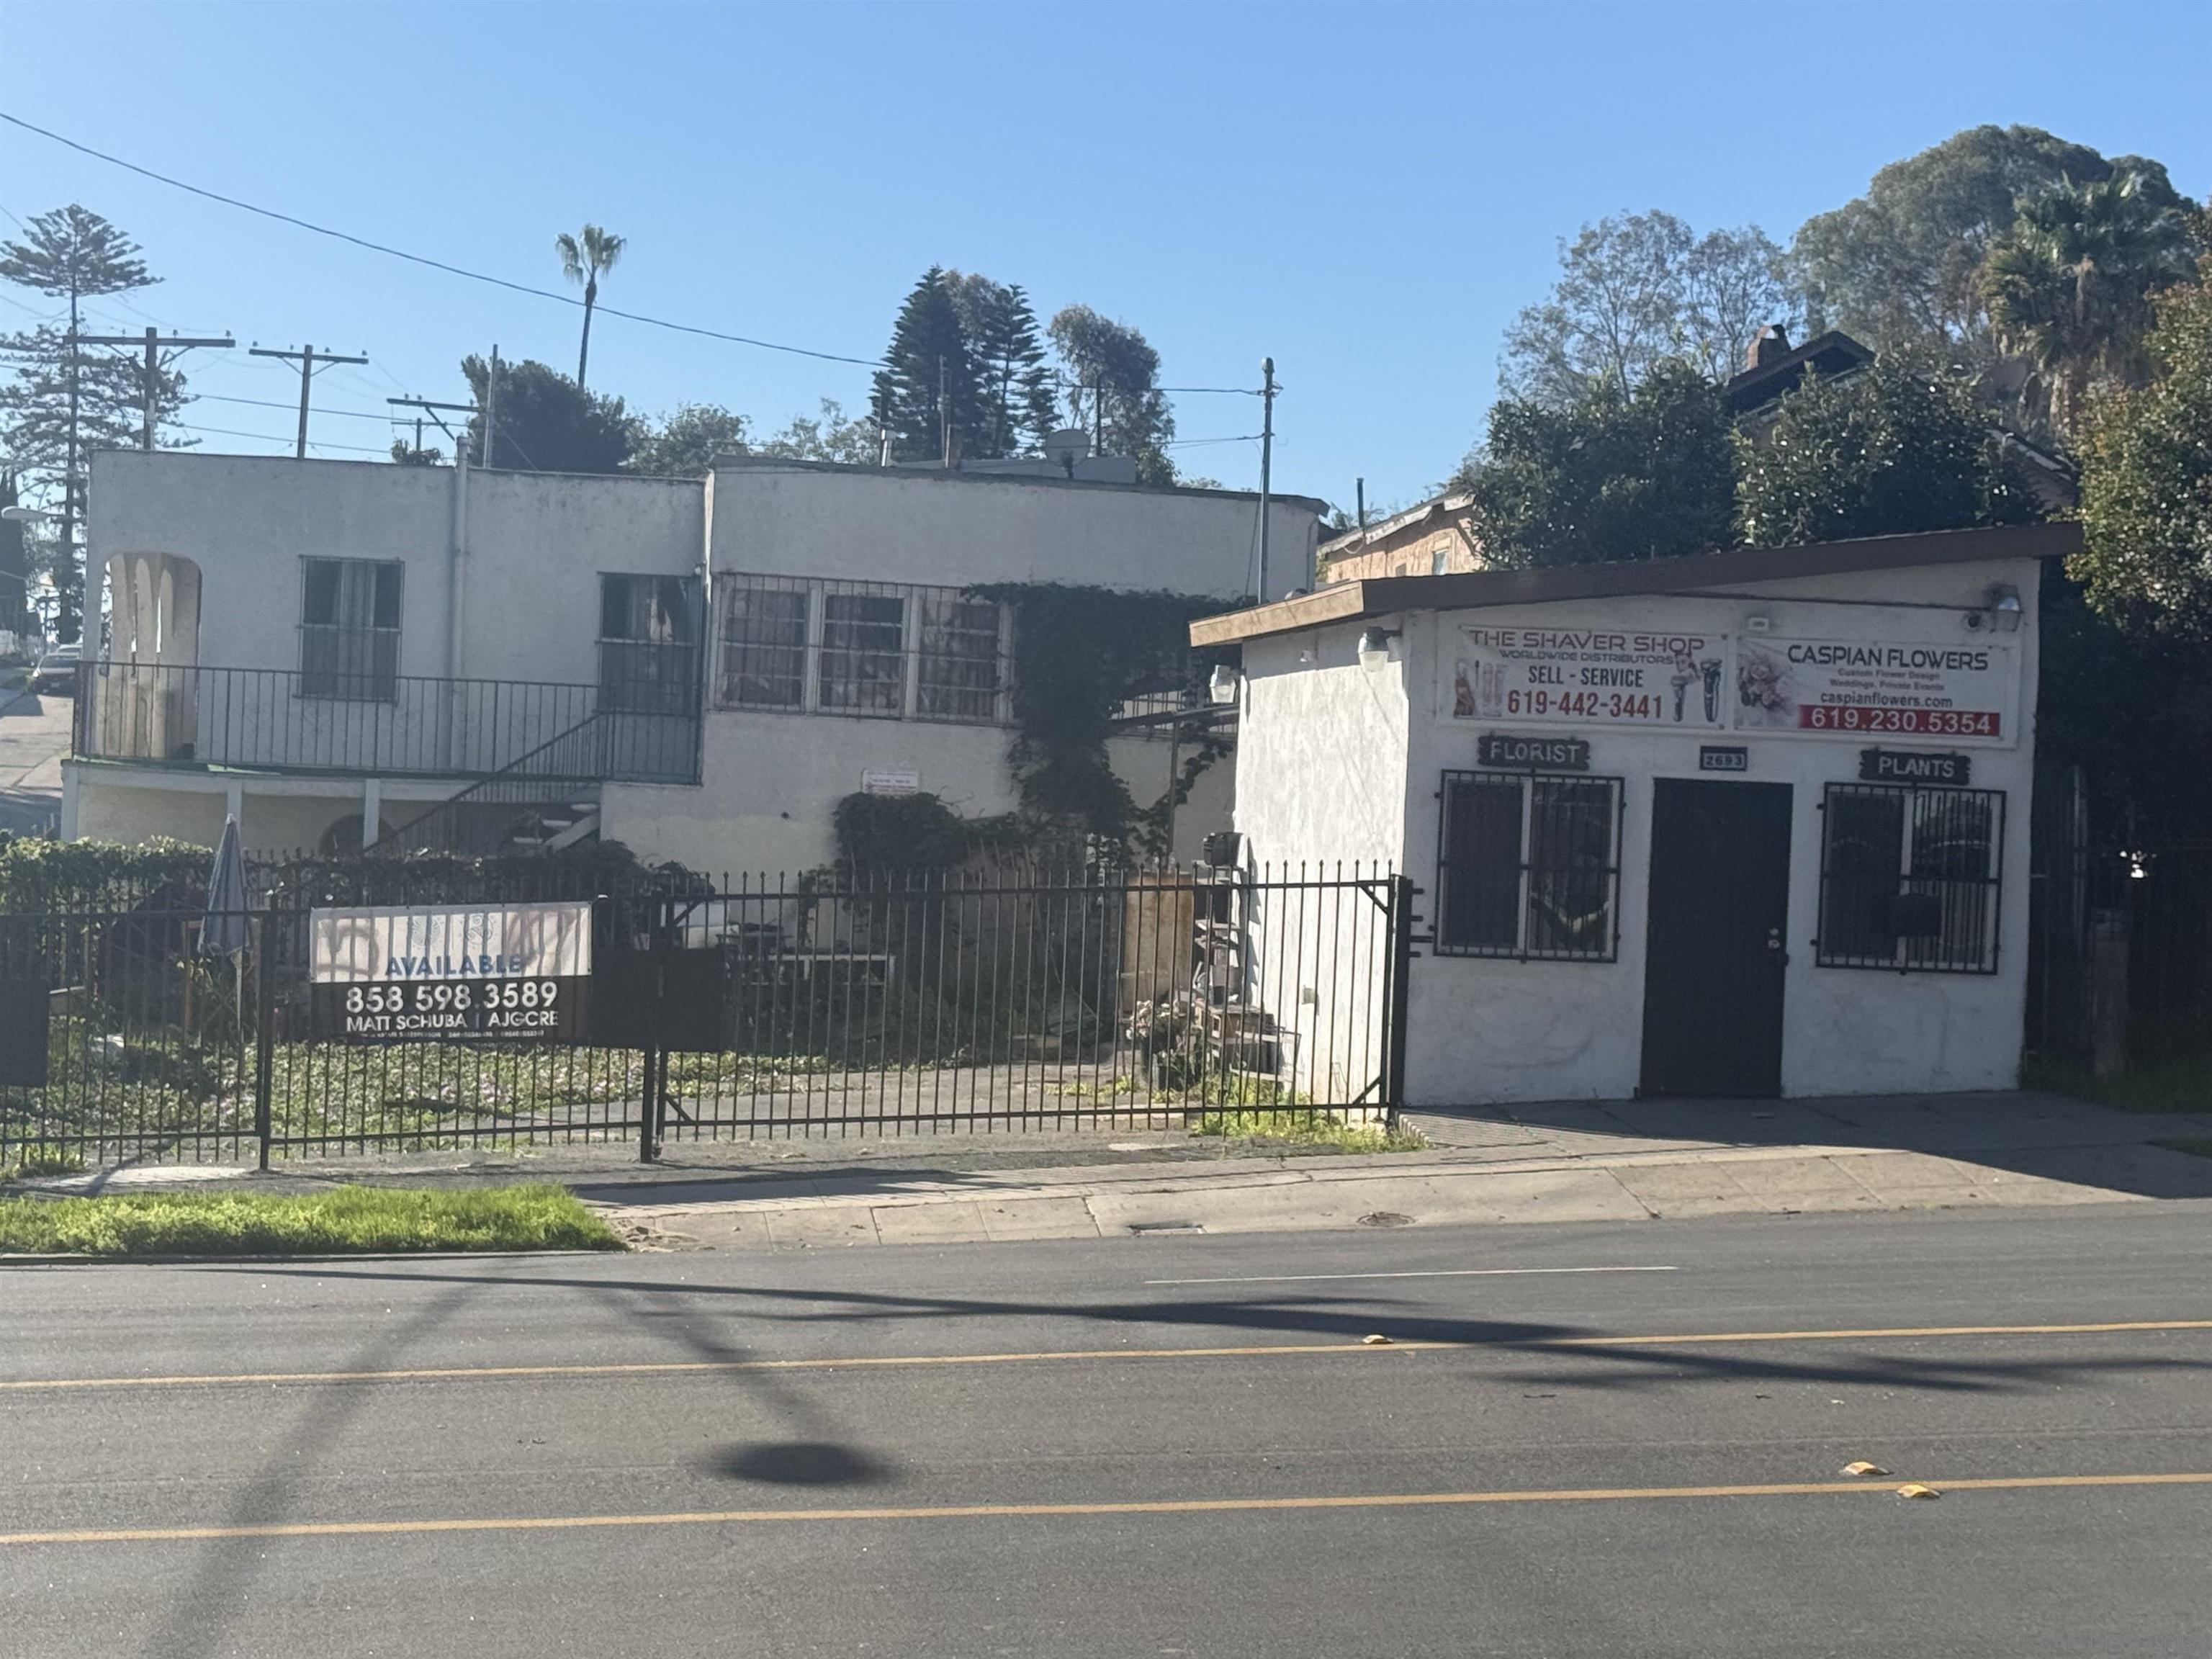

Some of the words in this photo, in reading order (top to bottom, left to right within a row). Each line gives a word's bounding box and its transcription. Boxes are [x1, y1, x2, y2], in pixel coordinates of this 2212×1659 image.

[1469, 629, 1516, 647] THE
[1523, 631, 1626, 652] SHAVER
[1633, 636, 1705, 654] SHOP
[1499, 649, 1578, 661] WORLDWIDE
[1581, 652, 1675, 665] DISTRIBUTORS
[1787, 644, 1882, 667] CASPIAN
[1887, 650, 1989, 671] FLOWERS
[1528, 666, 1564, 685] SELL
[1581, 667, 1644, 688] SERVICE
[1507, 690, 1662, 719] 619-442-3441
[1820, 691, 1953, 708] caspianflowers.com
[1811, 707, 1992, 734] 619.230.5354
[1489, 741, 1582, 763] FLORIST
[1878, 756, 1955, 778] PLANTS
[385, 954, 523, 976] AVAILABLE
[346, 1015, 392, 1033] MATT
[396, 1012, 467, 1030] SCHUBA
[487, 1010, 559, 1029] AJGCRE
